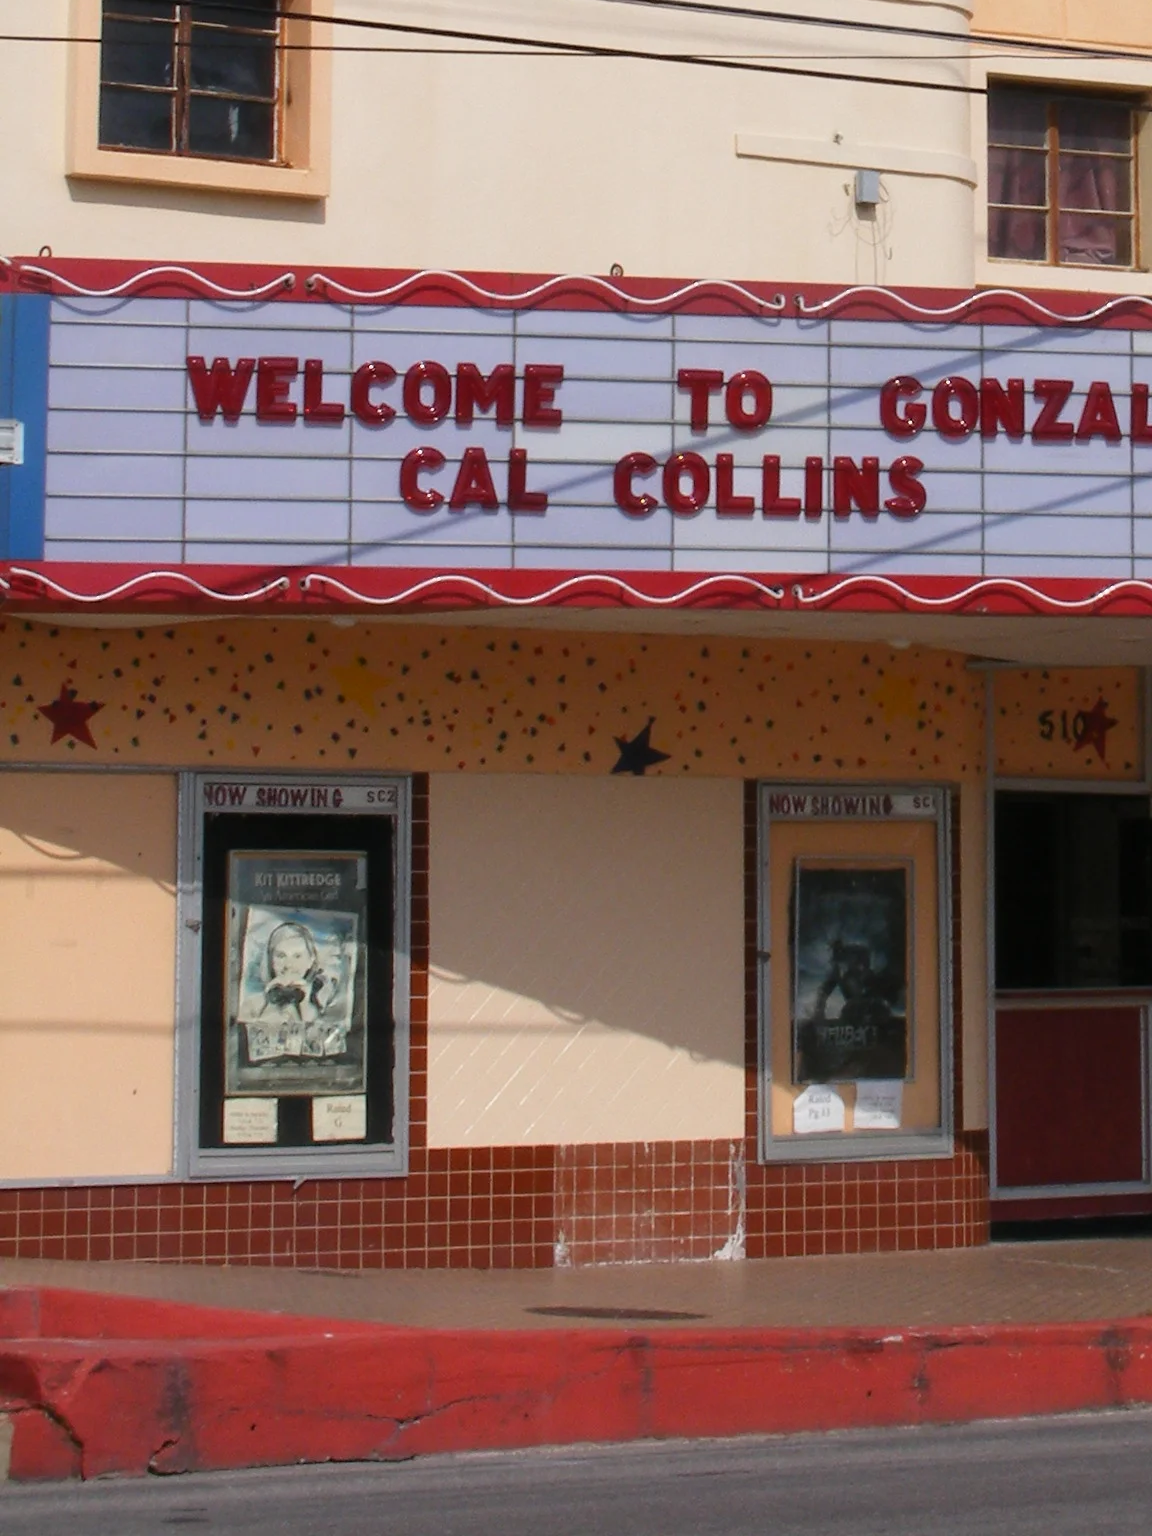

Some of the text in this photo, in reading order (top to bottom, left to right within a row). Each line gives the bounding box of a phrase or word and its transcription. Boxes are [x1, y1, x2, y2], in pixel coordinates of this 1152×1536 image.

[186, 356, 564, 427] WELCOME
[677, 369, 773, 431] TO
[400, 446, 928, 518] CAL COLLINS
[1037, 709, 1086, 742] 510
[255, 787, 344, 809] SHOWING
[769, 793, 806, 814] NOW
